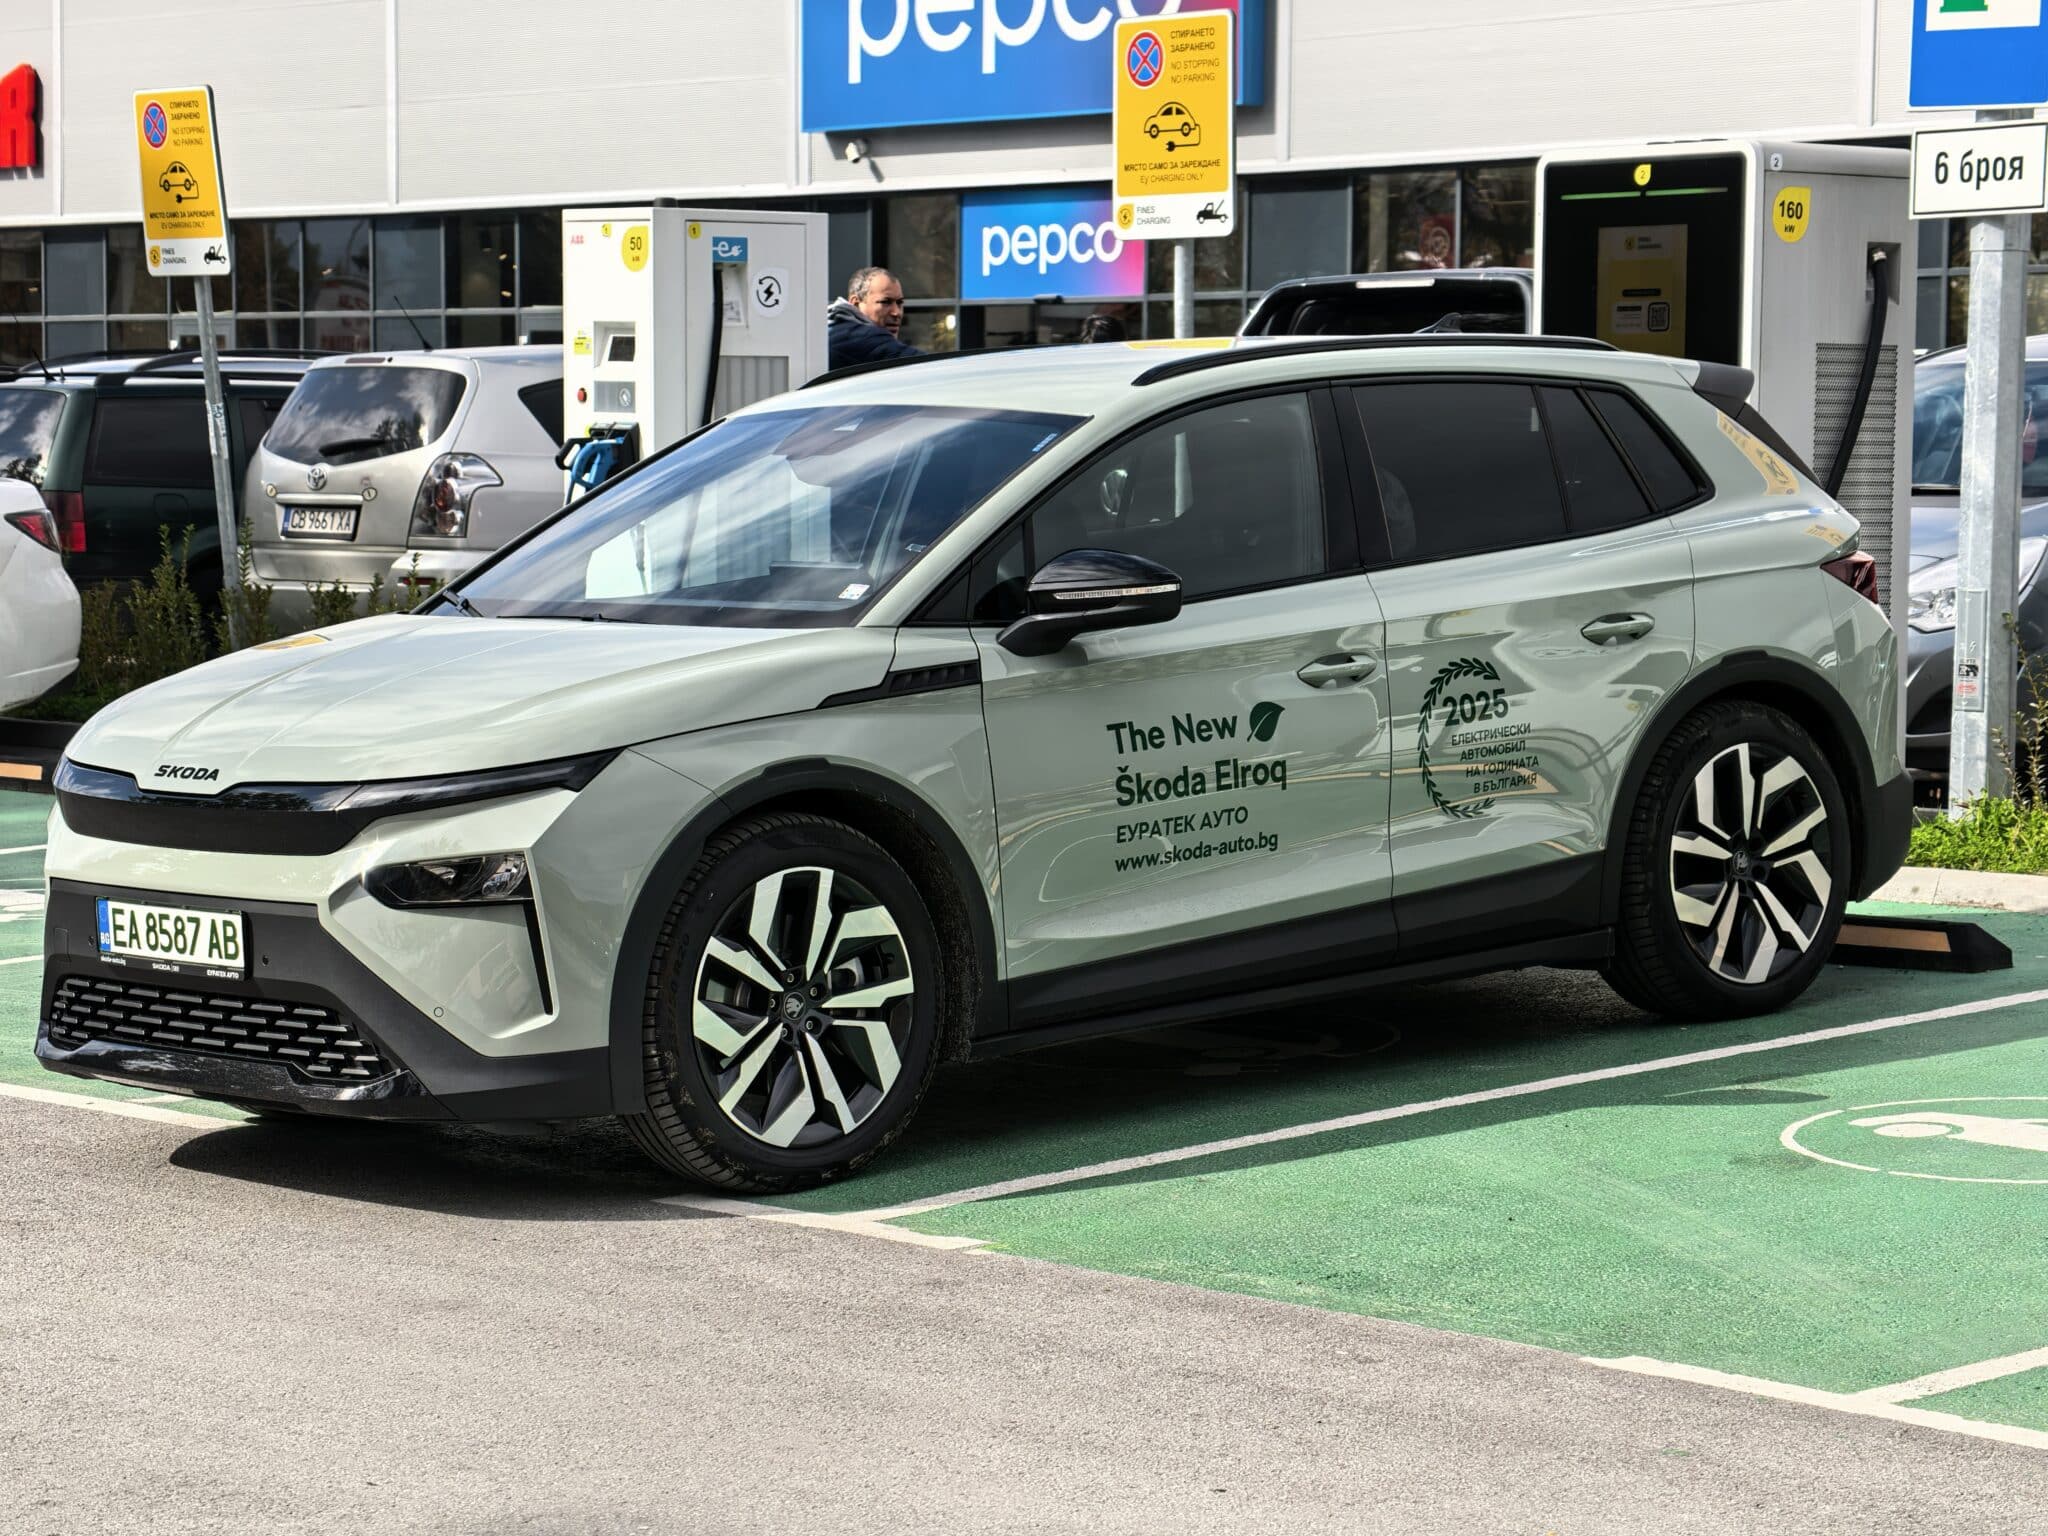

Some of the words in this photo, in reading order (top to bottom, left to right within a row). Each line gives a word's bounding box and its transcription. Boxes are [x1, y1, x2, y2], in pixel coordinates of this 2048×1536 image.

[1170, 28, 1215, 39] СПИРАНЕТО
[1170, 42, 1215, 53] ЗАБРАНЕНО
[1171, 62, 1181, 70] NO
[1183, 59, 1220, 69] STOPPING
[1171, 75, 1181, 83] NO
[1183, 73, 1215, 83] PARKING
[1124, 163, 1147, 172] МЯСТО
[1148, 162, 1168, 171] САМО
[1180, 159, 1221, 169] ЗАРЕЖДАНЕ
[1774, 157, 1779, 168] 2
[1935, 151, 1949, 185] 6
[1960, 148, 2024, 191] броя
[1778, 200, 1804, 220] 160
[1784, 224, 1795, 233] kW
[630, 236, 642, 251] 50
[982, 221, 1124, 276] pepco
[1442, 688, 1509, 727] 2025
[1106, 721, 1166, 754] The
[1171, 713, 1238, 746] New
[1451, 722, 1532, 746] ЕЛЕКТРИЧЕСКИ
[1460, 740, 1526, 762] АВТОМОБИЛ
[154, 765, 220, 782] SKODA
[1466, 766, 1480, 778] НА
[1482, 756, 1540, 776] ГОДИНАТА
[1115, 765, 1206, 807] Škoda
[1214, 758, 1287, 790] Elroq
[1474, 782, 1481, 794] В
[1483, 773, 1537, 792] БЪЛГАРИЯ
[1116, 814, 1196, 844] ЕУРАТЕК
[1199, 806, 1248, 830] АУТО
[1115, 831, 1278, 872] www.skoda-auto.bg
[112, 908, 142, 950] EA
[146, 912, 200, 956] 8587
[208, 918, 240, 960] AB
